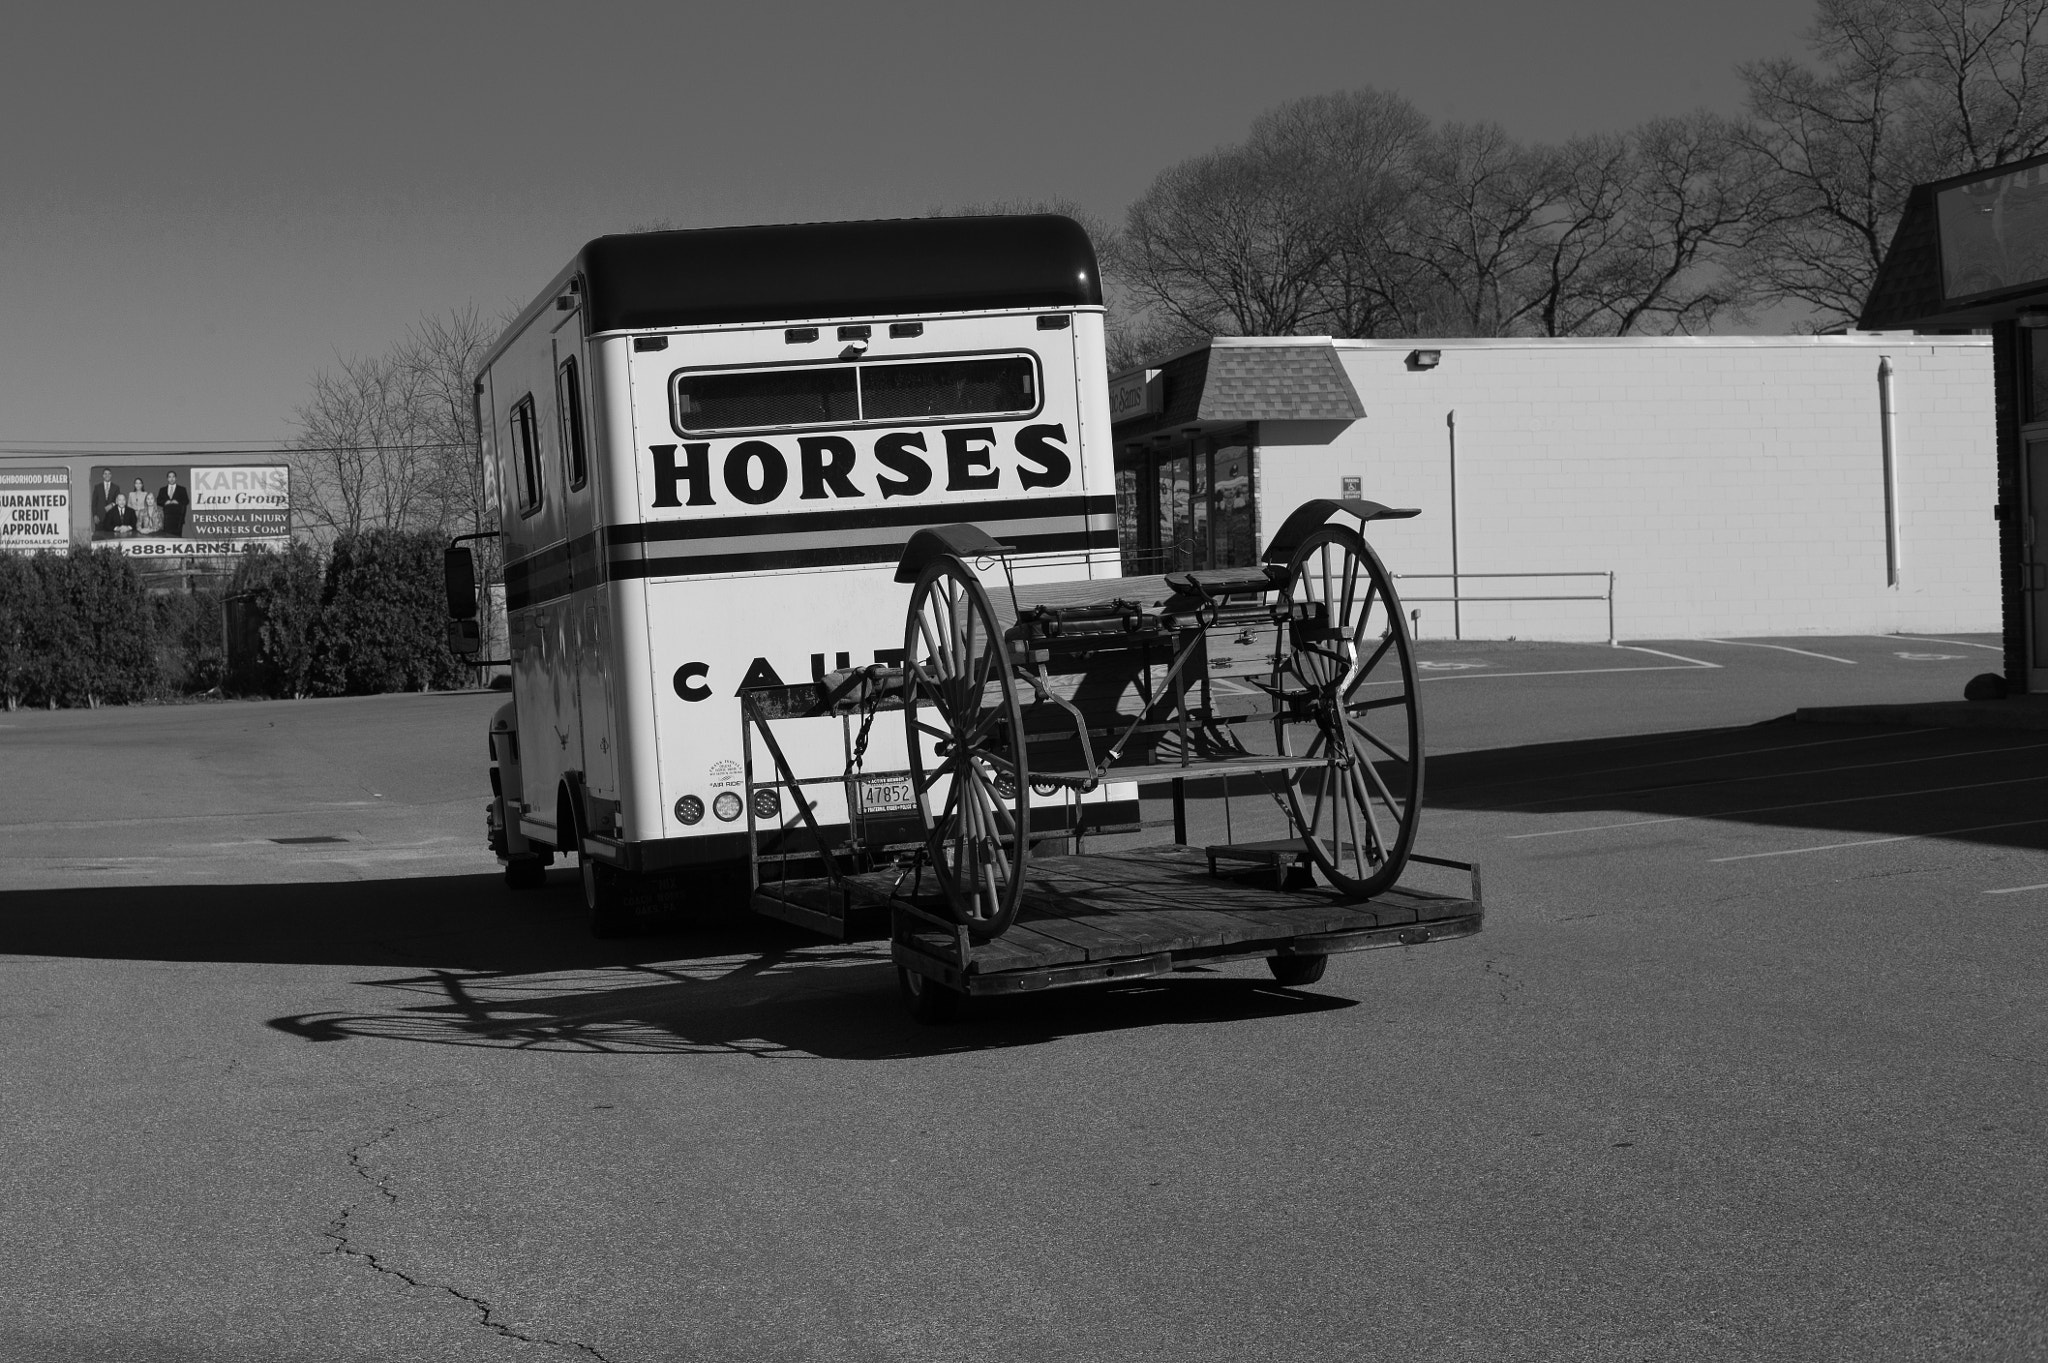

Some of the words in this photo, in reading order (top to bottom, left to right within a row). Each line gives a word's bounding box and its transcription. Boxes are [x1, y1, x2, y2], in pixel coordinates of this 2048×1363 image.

[649, 422, 1072, 507] HORSES
[43, 474, 68, 484] DEALER
[194, 471, 285, 490] KARNS
[0, 495, 67, 507] UARANTEED
[196, 493, 231, 504] Law
[235, 492, 286, 506] Group
[12, 509, 49, 521] CREDIT
[193, 514, 246, 522] PERSONAL
[251, 513, 288, 522] INJURY
[3, 523, 59, 535] APPROVAL
[196, 525, 250, 534] WORKERS
[253, 524, 286, 533] COMP
[866, 785, 910, 803] 47852
